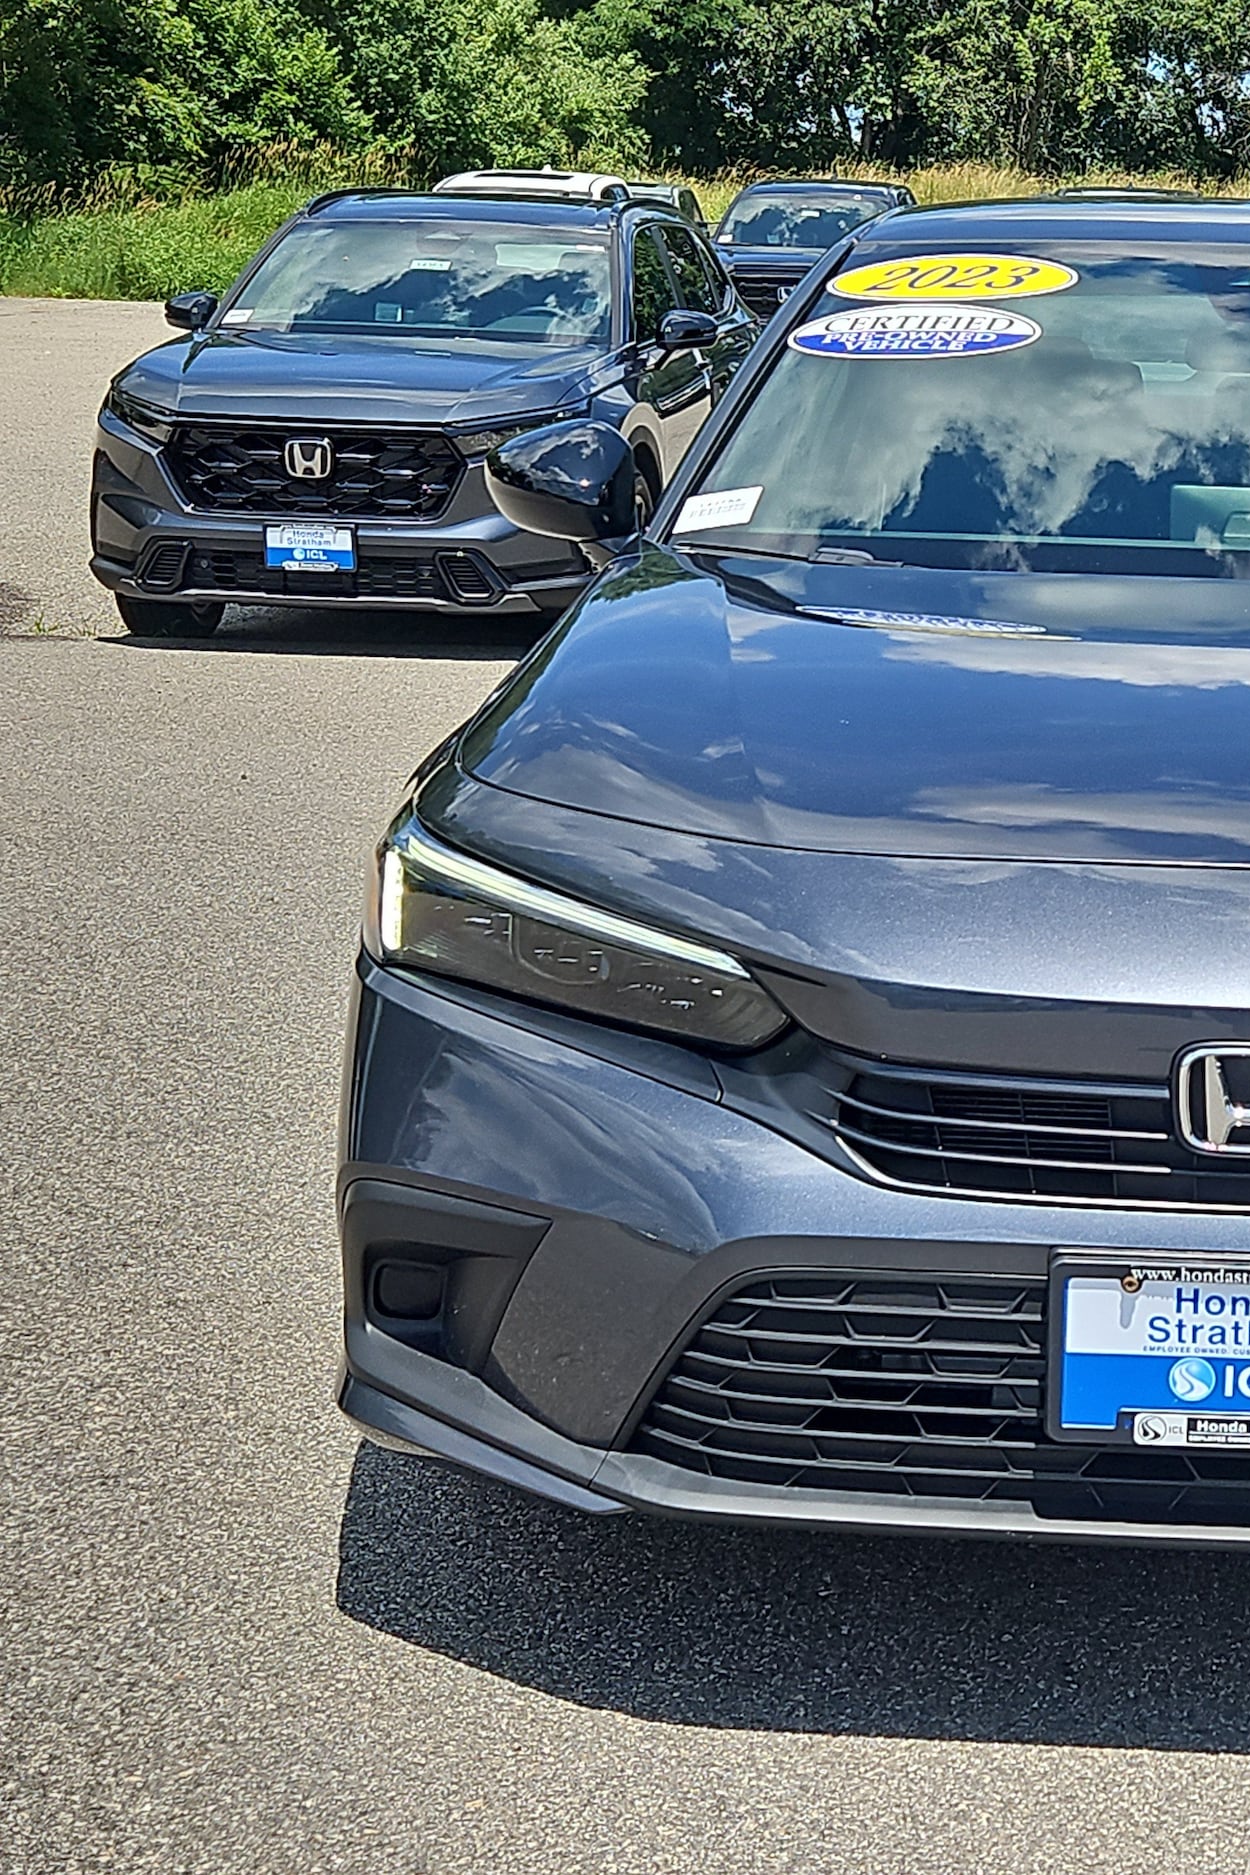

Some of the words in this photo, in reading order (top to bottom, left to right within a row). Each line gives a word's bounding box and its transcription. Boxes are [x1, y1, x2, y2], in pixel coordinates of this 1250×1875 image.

[864, 264, 1041, 292] 2023
[824, 315, 1015, 331] CERTIFIED
[821, 330, 998, 345] PRE-OWNED
[845, 340, 967, 352] VEHICLE
[293, 529, 325, 539] Honda
[287, 538, 332, 547] Stratham
[306, 549, 328, 561] ICL
[1142, 1345, 1192, 1354] EMPLOYEE
[1168, 1425, 1184, 1435] ICL
[1196, 1420, 1248, 1434] Honda
